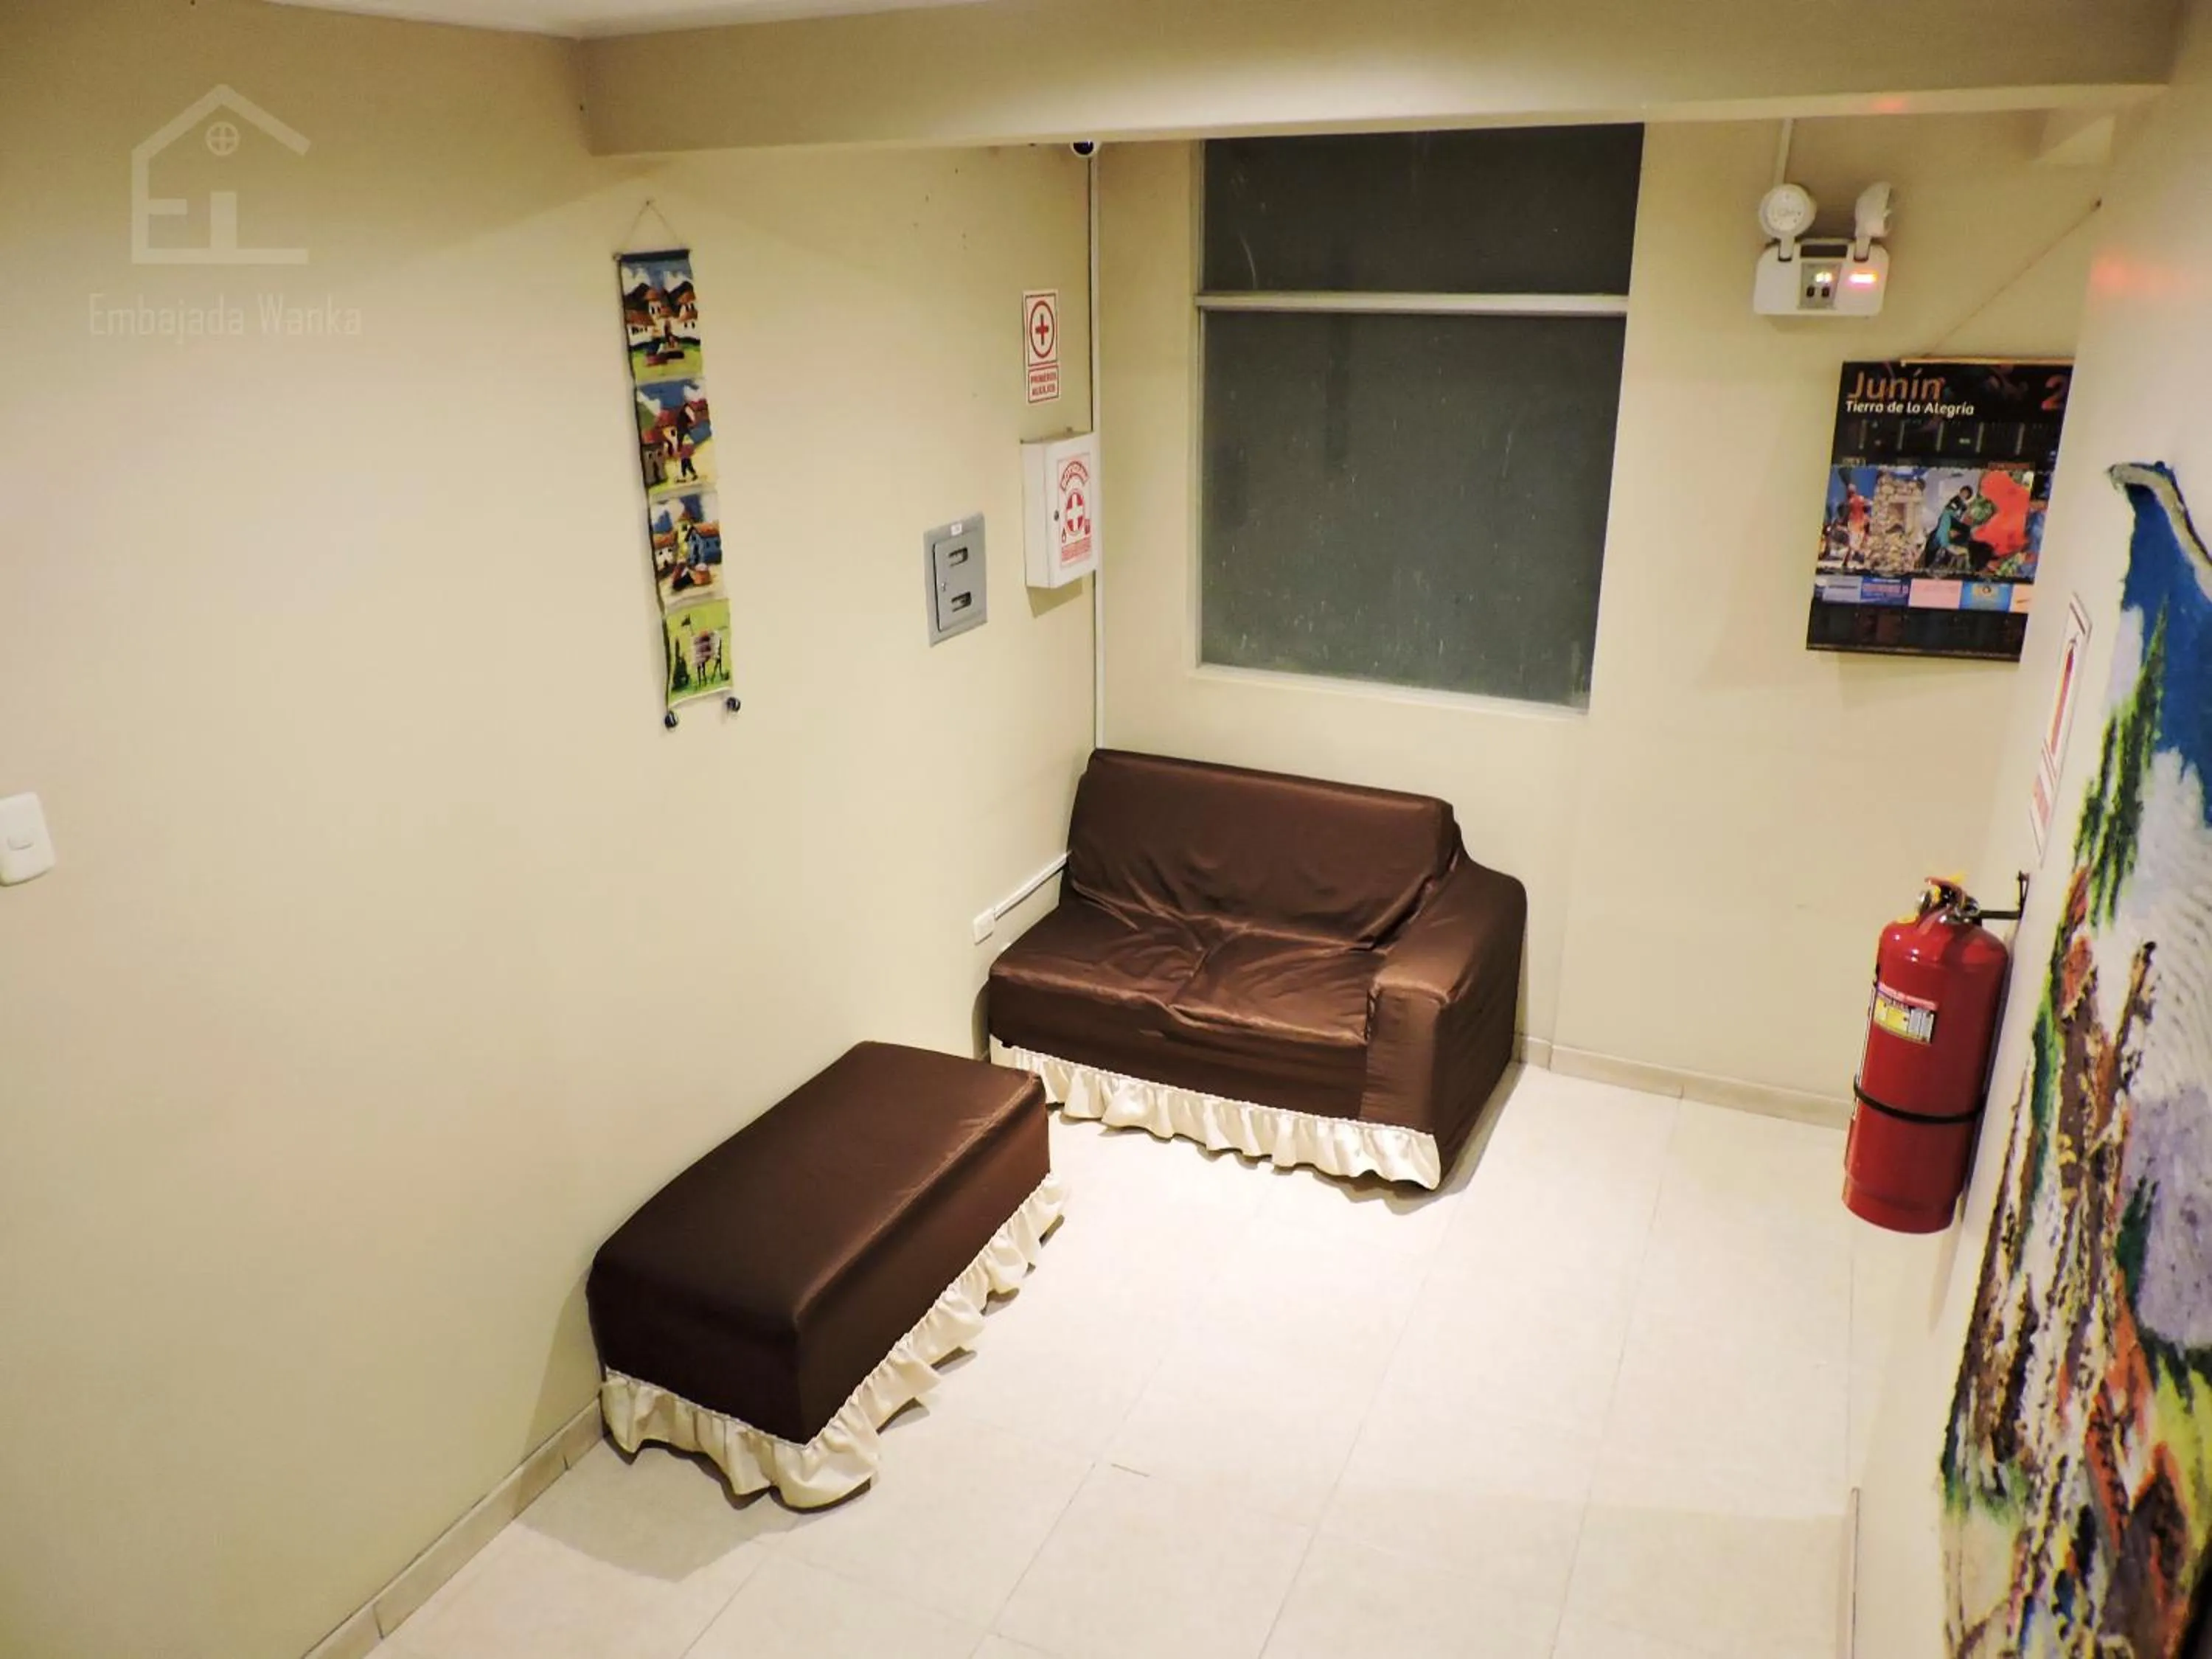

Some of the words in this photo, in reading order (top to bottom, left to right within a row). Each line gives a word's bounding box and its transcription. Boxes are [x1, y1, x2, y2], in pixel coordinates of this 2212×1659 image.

[1847, 368, 1944, 400] Junín
[1846, 400, 1884, 414] Tierra
[1887, 401, 1904, 414] de
[1924, 401, 1975, 419] Alegría
